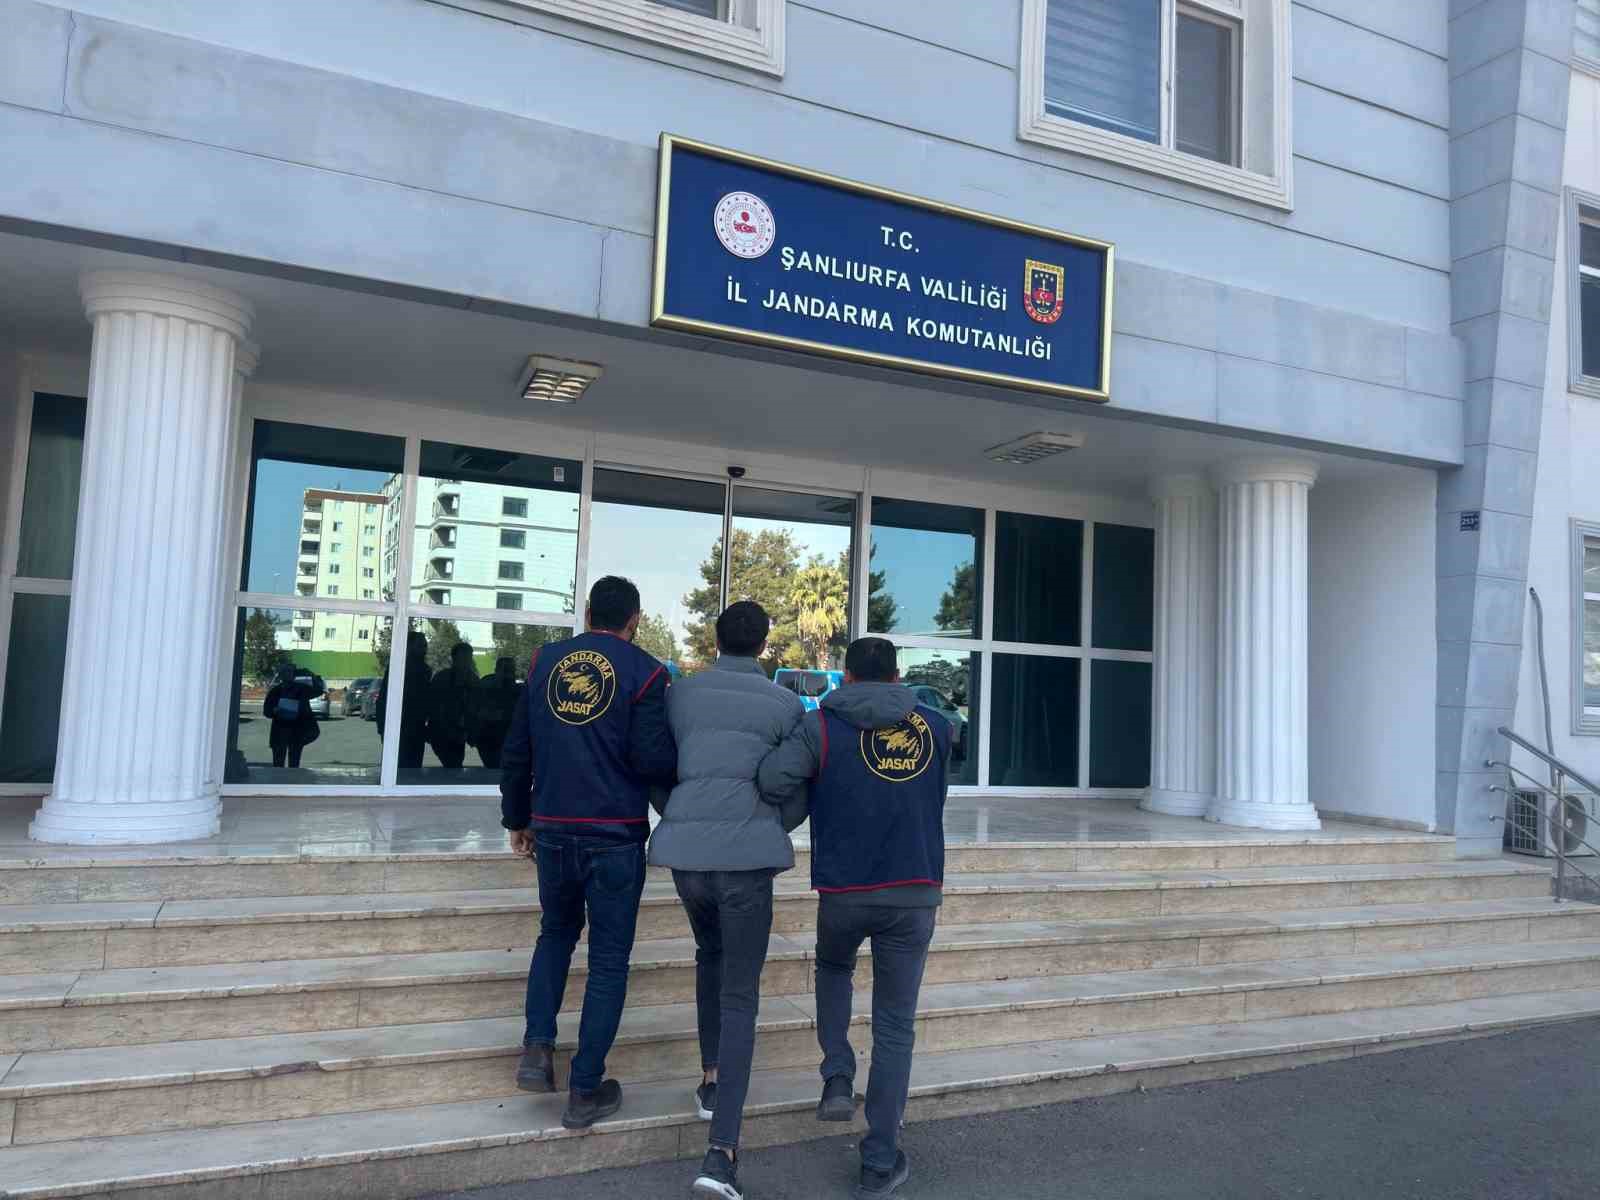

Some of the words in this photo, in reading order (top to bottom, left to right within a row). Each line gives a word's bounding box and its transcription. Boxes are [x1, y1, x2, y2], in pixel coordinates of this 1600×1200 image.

[881, 225, 919, 253] T.C.
[781, 246, 911, 292] ŞANLIURFA
[921, 276, 1007, 311] VALİLİĞİ
[727, 275, 747, 304] İL
[763, 289, 894, 332] JANDARMA
[907, 316, 1051, 360] KOMUTANLIĞI
[559, 652, 613, 680] JANDARMA
[557, 700, 593, 716] JASAT
[877, 757, 918, 770] JASAT
